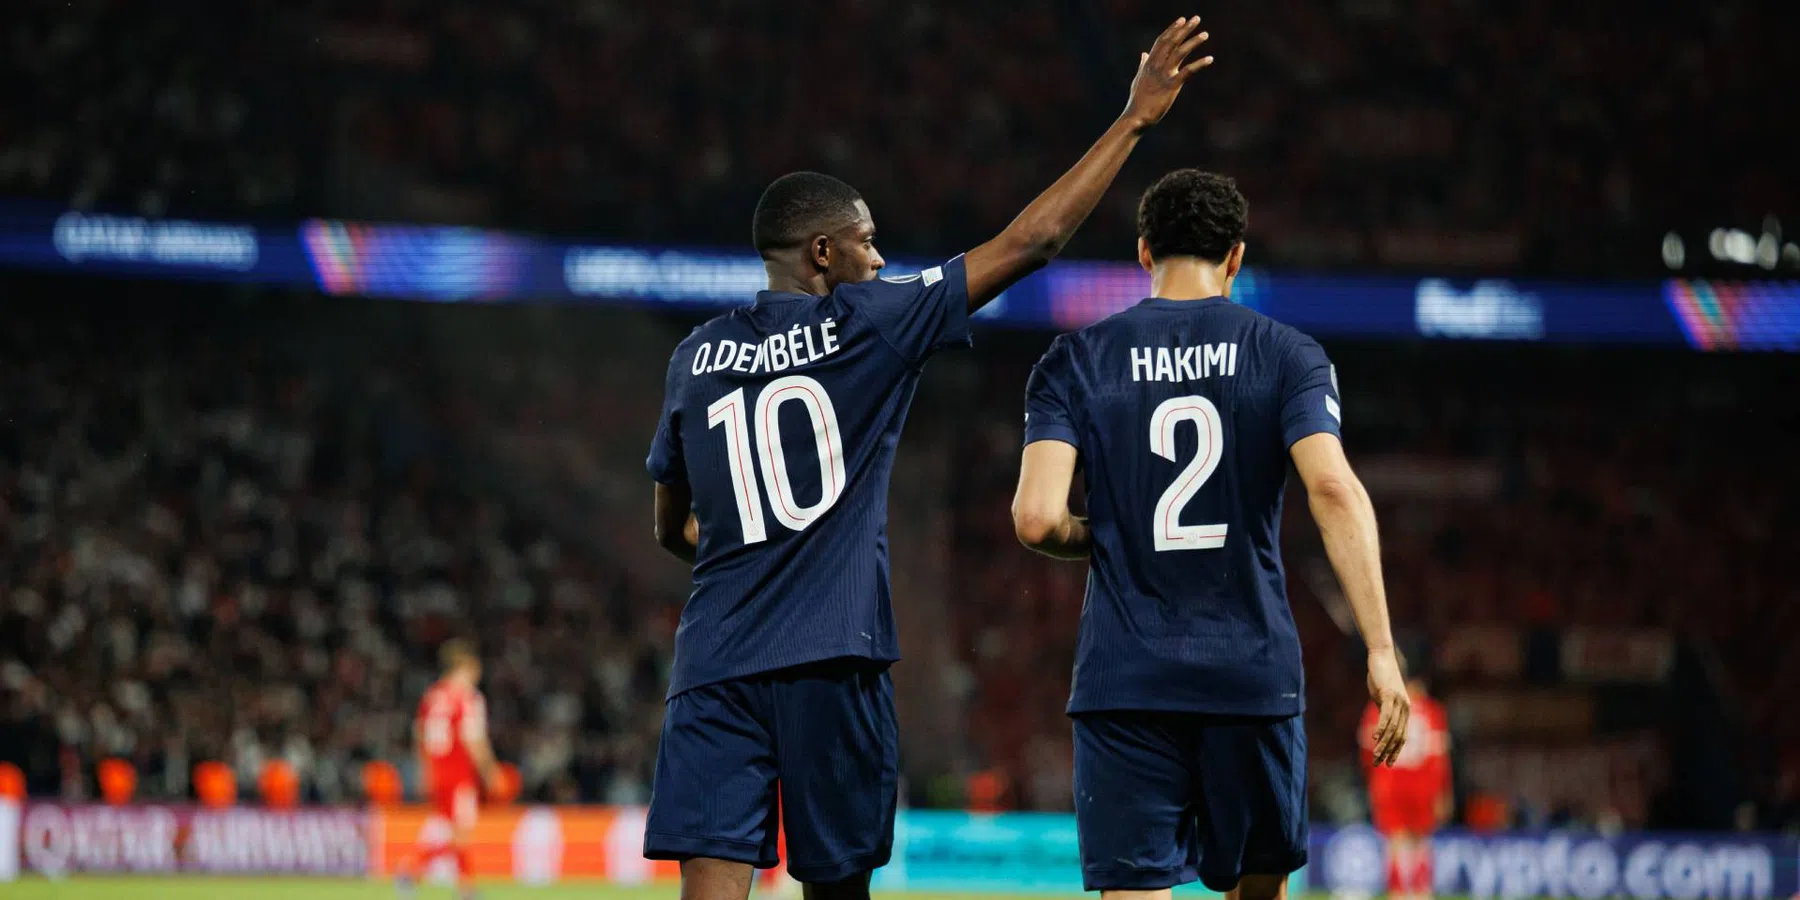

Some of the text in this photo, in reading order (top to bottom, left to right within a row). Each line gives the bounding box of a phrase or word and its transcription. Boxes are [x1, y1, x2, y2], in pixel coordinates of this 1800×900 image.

[692, 318, 840, 376] O.DEMBÉLÉ
[1130, 342, 1238, 382] HAKIMI
[707, 375, 846, 545] 10
[1149, 394, 1229, 552] 2
[1432, 834, 1774, 899] rypto.com
